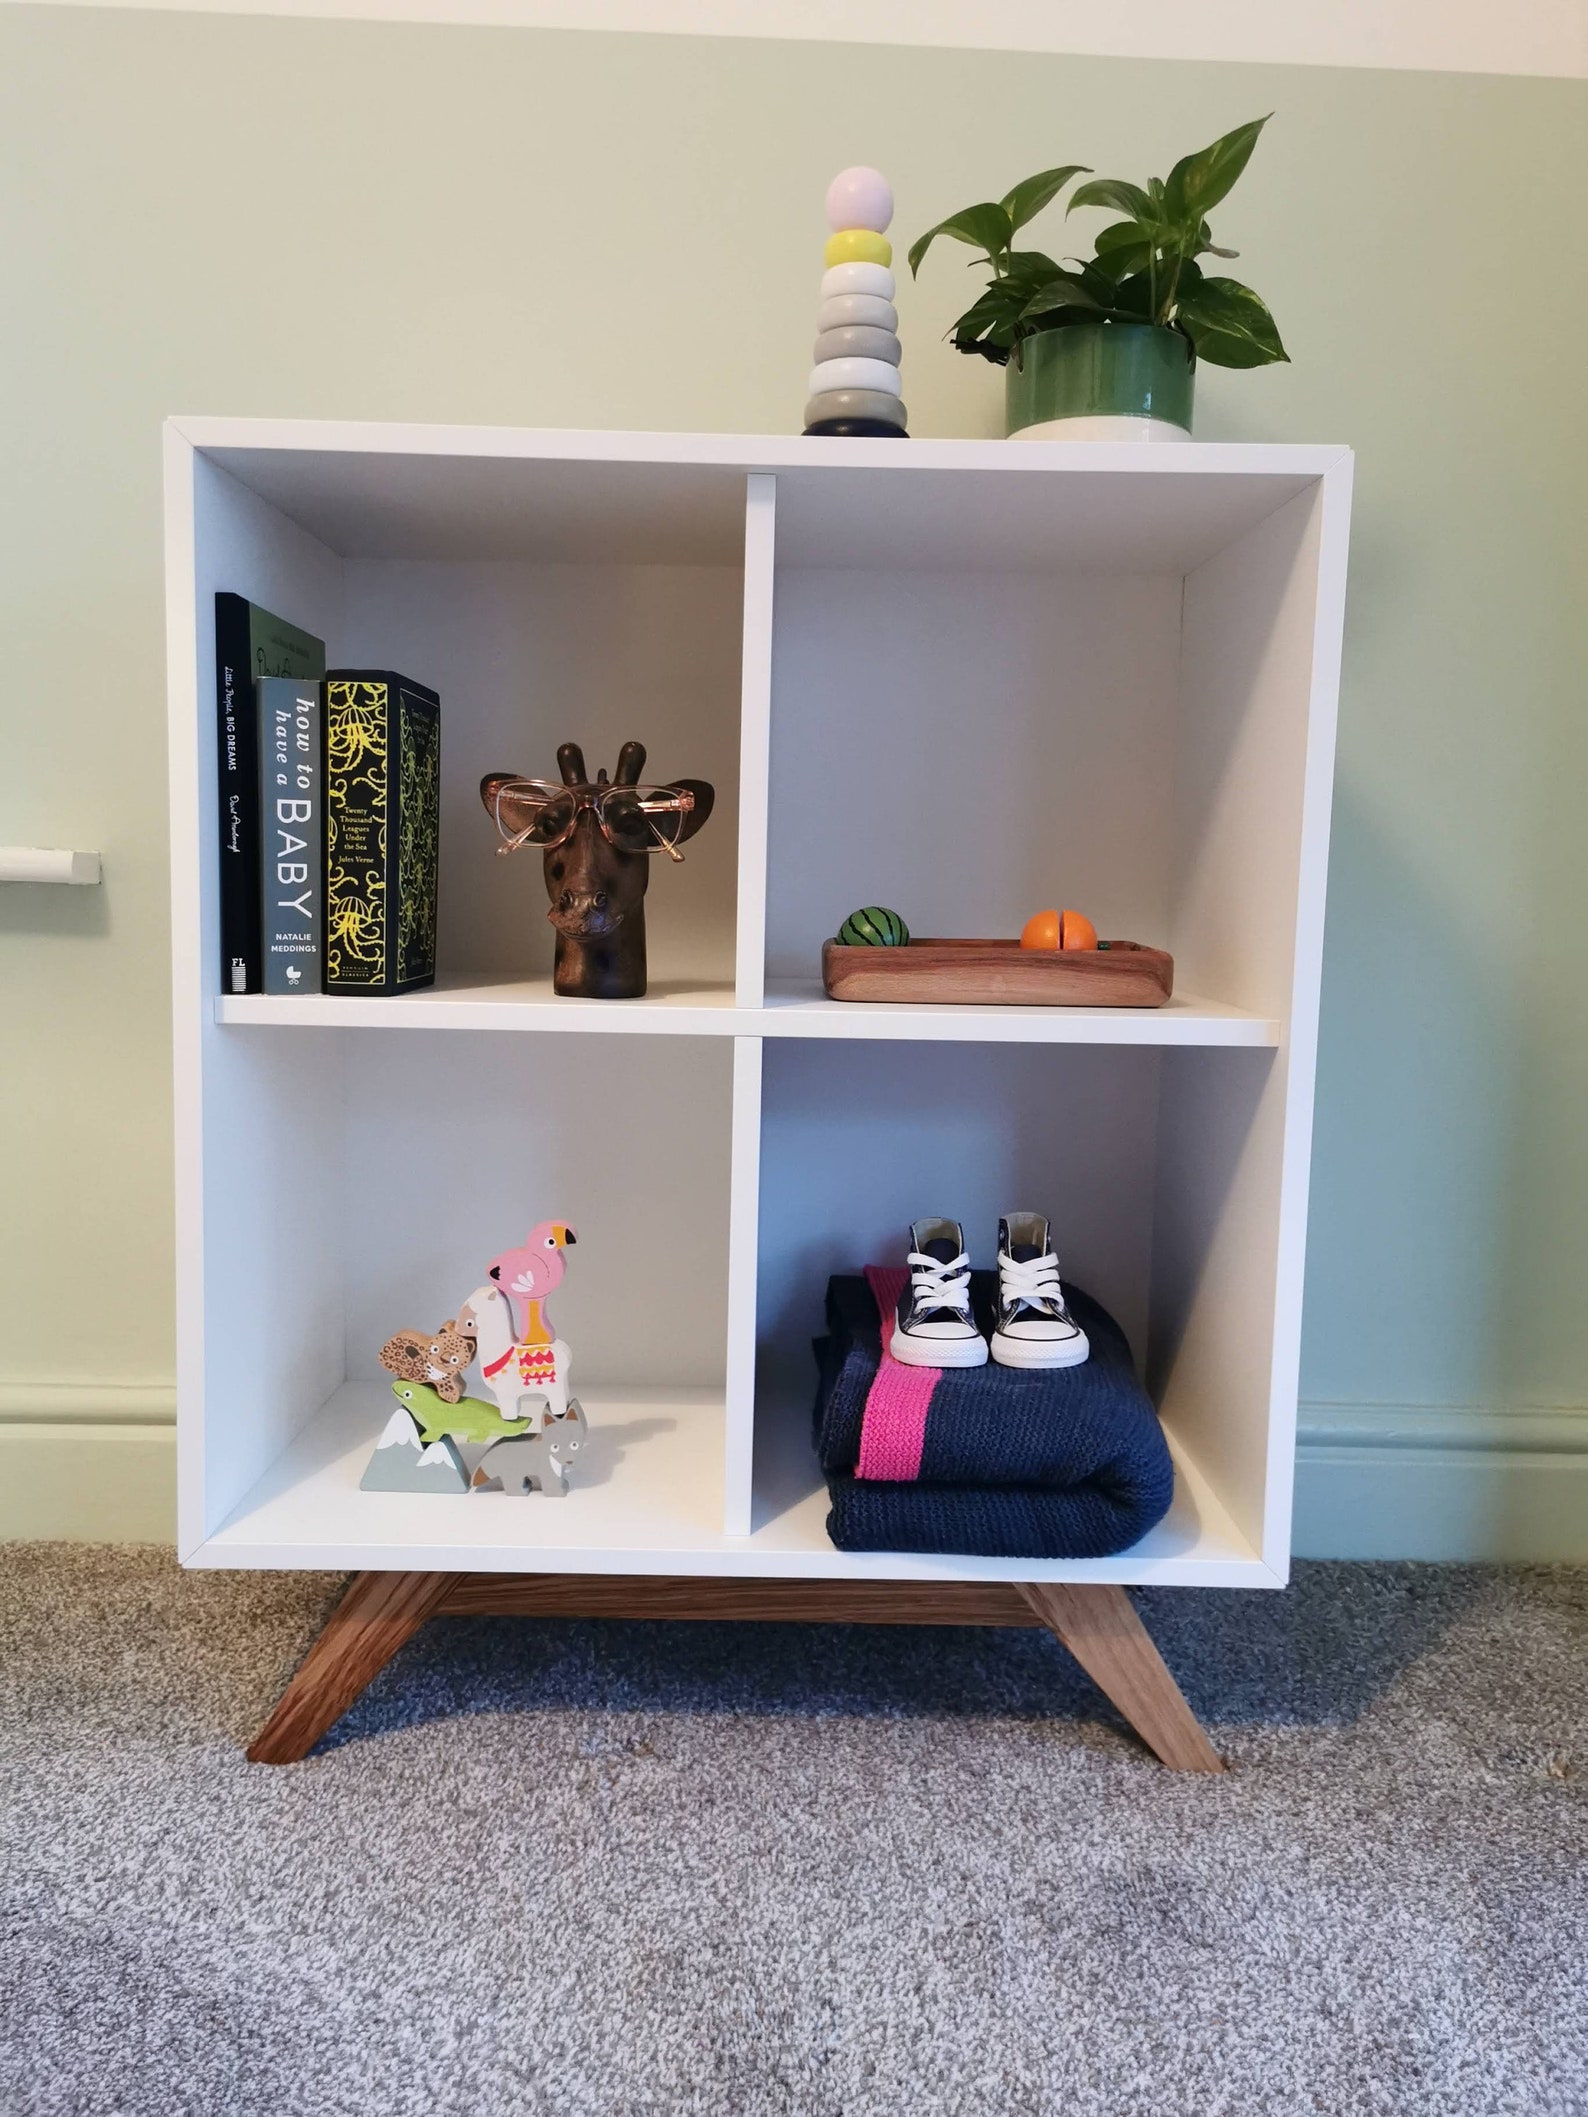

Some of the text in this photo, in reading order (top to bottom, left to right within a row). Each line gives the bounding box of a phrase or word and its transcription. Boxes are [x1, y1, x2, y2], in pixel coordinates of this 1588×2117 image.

[222, 666, 237, 771] Little People, BIG DREAMS
[275, 710, 291, 786] have a
[295, 697, 315, 790] how to
[344, 806, 368, 815] Twenty
[340, 815, 372, 823] Thousand
[342, 824, 370, 834] Leagues
[345, 833, 367, 841] Under
[276, 798, 313, 919] BABY
[338, 855, 374, 864] Jules Verne
[275, 933, 312, 941] NATALIE
[270, 945, 317, 953] MEDDINGS
[231, 957, 246, 967] FL
